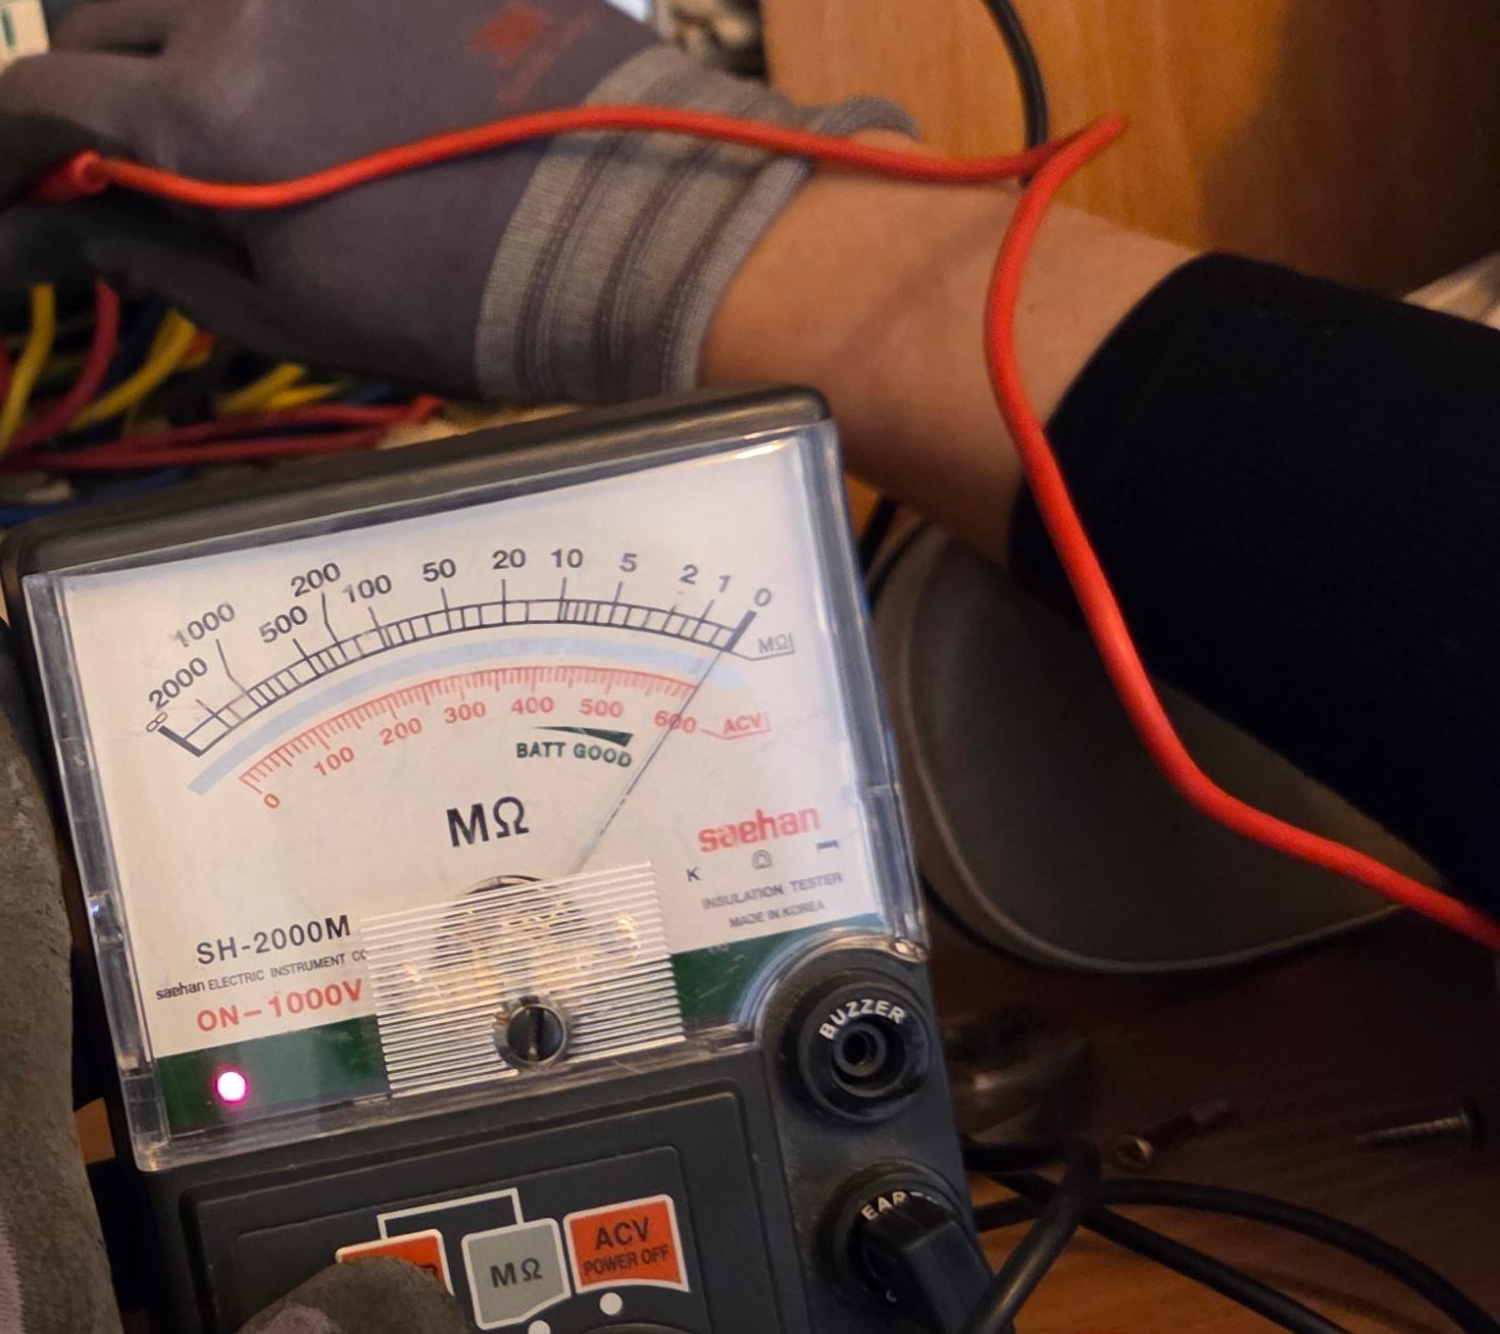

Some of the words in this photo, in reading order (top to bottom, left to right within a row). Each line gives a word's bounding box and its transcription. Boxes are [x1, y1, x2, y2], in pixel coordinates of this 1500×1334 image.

[423, 559, 456, 582] 50
[492, 548, 526, 569] 20
[551, 548, 583, 568] 10
[620, 553, 637, 572] 5
[291, 562, 341, 597] 200
[679, 564, 699, 585] 2
[718, 575, 731, 593] 1
[343, 575, 392, 603] 100
[754, 587, 772, 607] 0
[173, 602, 235, 647] 1000
[259, 605, 308, 643] 500
[149, 657, 207, 711] 2000
[444, 701, 486, 724] 300
[511, 696, 554, 714] 400
[580, 698, 623, 718] 500
[380, 717, 422, 746] 200
[655, 710, 696, 733] 600
[724, 713, 762, 733] ACV
[314, 746, 354, 776] 100
[516, 742, 566, 758] BATT
[573, 743, 632, 767] GOOD
[263, 793, 281, 810] 0
[446, 796, 529, 847] MΩ
[698, 807, 821, 853] saehan
[702, 884, 784, 910] INSULATION
[790, 872, 842, 892] TESTER
[729, 913, 764, 928] MADE
[766, 909, 781, 920] IN
[783, 900, 825, 916] KOREA
[197, 915, 350, 964] SH-2000M
[156, 980, 205, 1000] saehan
[208, 970, 264, 990] ELECTRIC
[270, 953, 346, 979] INSTRUMENT
[818, 998, 906, 1040] BUZZER
[596, 1216, 648, 1250] ACV
[490, 1257, 542, 1289] MΩ
[583, 1251, 638, 1275] POWER
[641, 1244, 668, 1264] OFF
